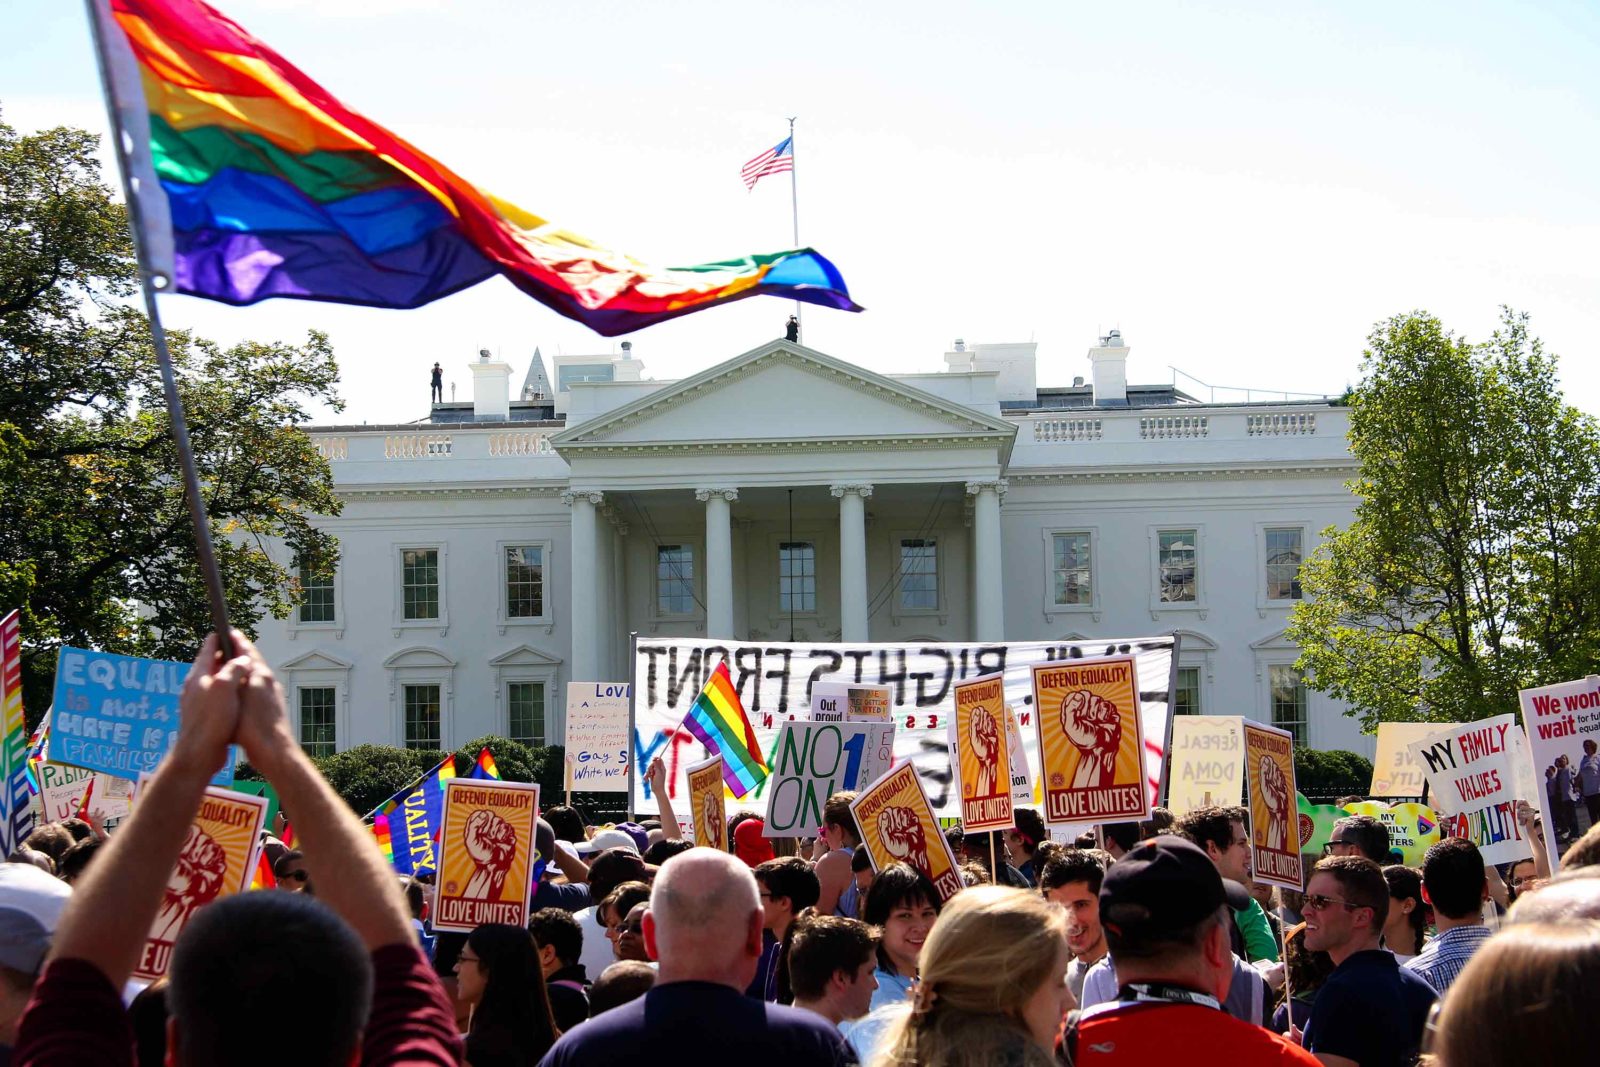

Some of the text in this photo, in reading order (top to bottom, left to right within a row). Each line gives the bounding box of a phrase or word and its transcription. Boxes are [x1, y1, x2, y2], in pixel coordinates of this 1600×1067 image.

[64, 653, 185, 695] EQUAL
[1041, 667, 1128, 689] DEFEND EQUALITY
[820, 698, 837, 711] Out
[958, 684, 1000, 705] DEFEND EQUALITY
[1532, 694, 1562, 717] We
[1537, 714, 1577, 741] wait
[1577, 714, 1589, 724] for
[578, 750, 612, 764] Gay
[780, 725, 843, 778] NO
[1248, 732, 1289, 758] DEFEND EQUALITY
[1420, 723, 1509, 774] MY FAMILY
[842, 733, 866, 791] 1
[859, 771, 912, 821] DEFEND EQUALITY
[1454, 768, 1502, 802] VALUES
[452, 789, 530, 809] DEFEND EQUALITY
[770, 777, 834, 831] ON
[965, 796, 1010, 823] LOVE UNITES
[1051, 787, 1140, 817] LOVE UNITES
[202, 801, 254, 828] QUALITY
[1380, 813, 1396, 821] MY
[403, 789, 436, 870] UALITY
[1386, 826, 1408, 834] MILY
[1389, 838, 1415, 846] TERS
[1256, 848, 1299, 880] LOVE UNITES
[934, 872, 960, 901] TES
[442, 899, 520, 926] LOVE UNITES
